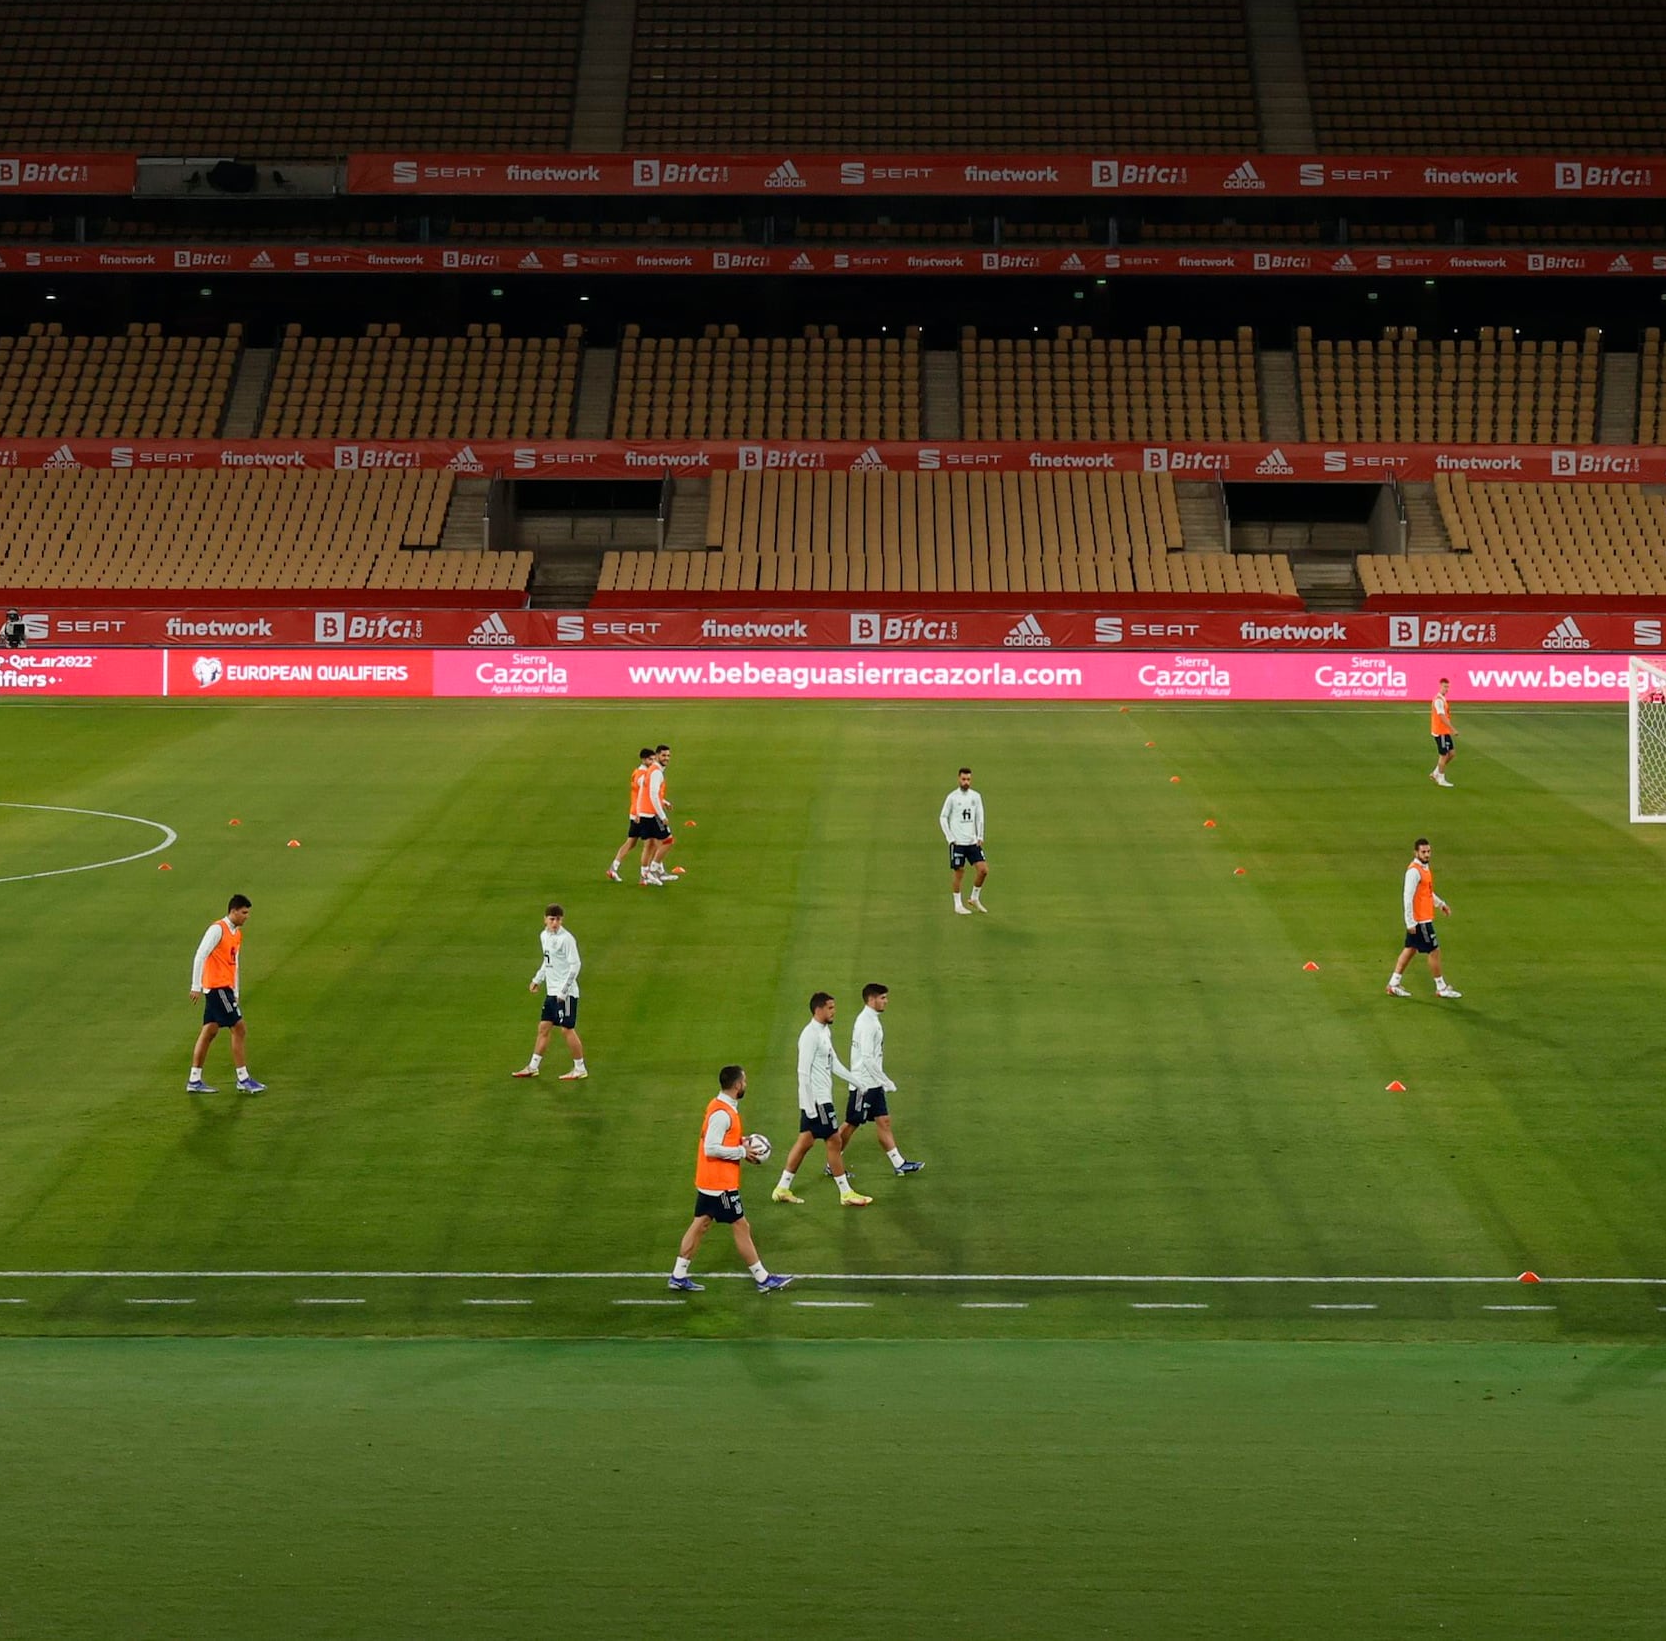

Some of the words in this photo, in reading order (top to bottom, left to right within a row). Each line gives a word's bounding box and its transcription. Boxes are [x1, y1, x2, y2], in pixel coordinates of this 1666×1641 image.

[872, 169, 932, 178] SEAT
[965, 166, 1058, 181] finetwork
[1223, 178, 1265, 189] adidas
[100, 255, 155, 264] finetwork
[1179, 257, 1234, 266] finetwork
[140, 453, 194, 462] SEAT
[221, 451, 304, 465] finetwork
[625, 451, 709, 465] finetwork
[947, 455, 1001, 463] SEAT
[1029, 453, 1114, 467] finetwork
[1436, 455, 1521, 469] finetwork
[1256, 463, 1293, 474] adidas
[57, 621, 125, 631] SEAT
[166, 618, 272, 635] finetwork
[593, 623, 661, 634] SEAT
[701, 620, 807, 637] finetwork
[1131, 625, 1199, 635] SEAT
[1240, 622, 1346, 640] finetwork
[468, 631, 515, 644] adidas
[1004, 633, 1051, 646] adidas
[1543, 635, 1590, 648] adidas
[512, 654, 546, 664] Sierra
[1175, 657, 1209, 667] Sierra
[1351, 657, 1385, 668] Sierra
[227, 666, 312, 680] EUROPEAN
[317, 666, 408, 680] QUALIFIERS
[476, 662, 567, 683] Cazorla
[629, 662, 1081, 690] www.bebeaguasierracazorla.com
[1138, 665, 1230, 686] Cazorla
[1315, 665, 1406, 687] Cazorla
[491, 685, 510, 694] Agua
[1153, 687, 1173, 696] Agua
[1330, 688, 1350, 697] Agua
